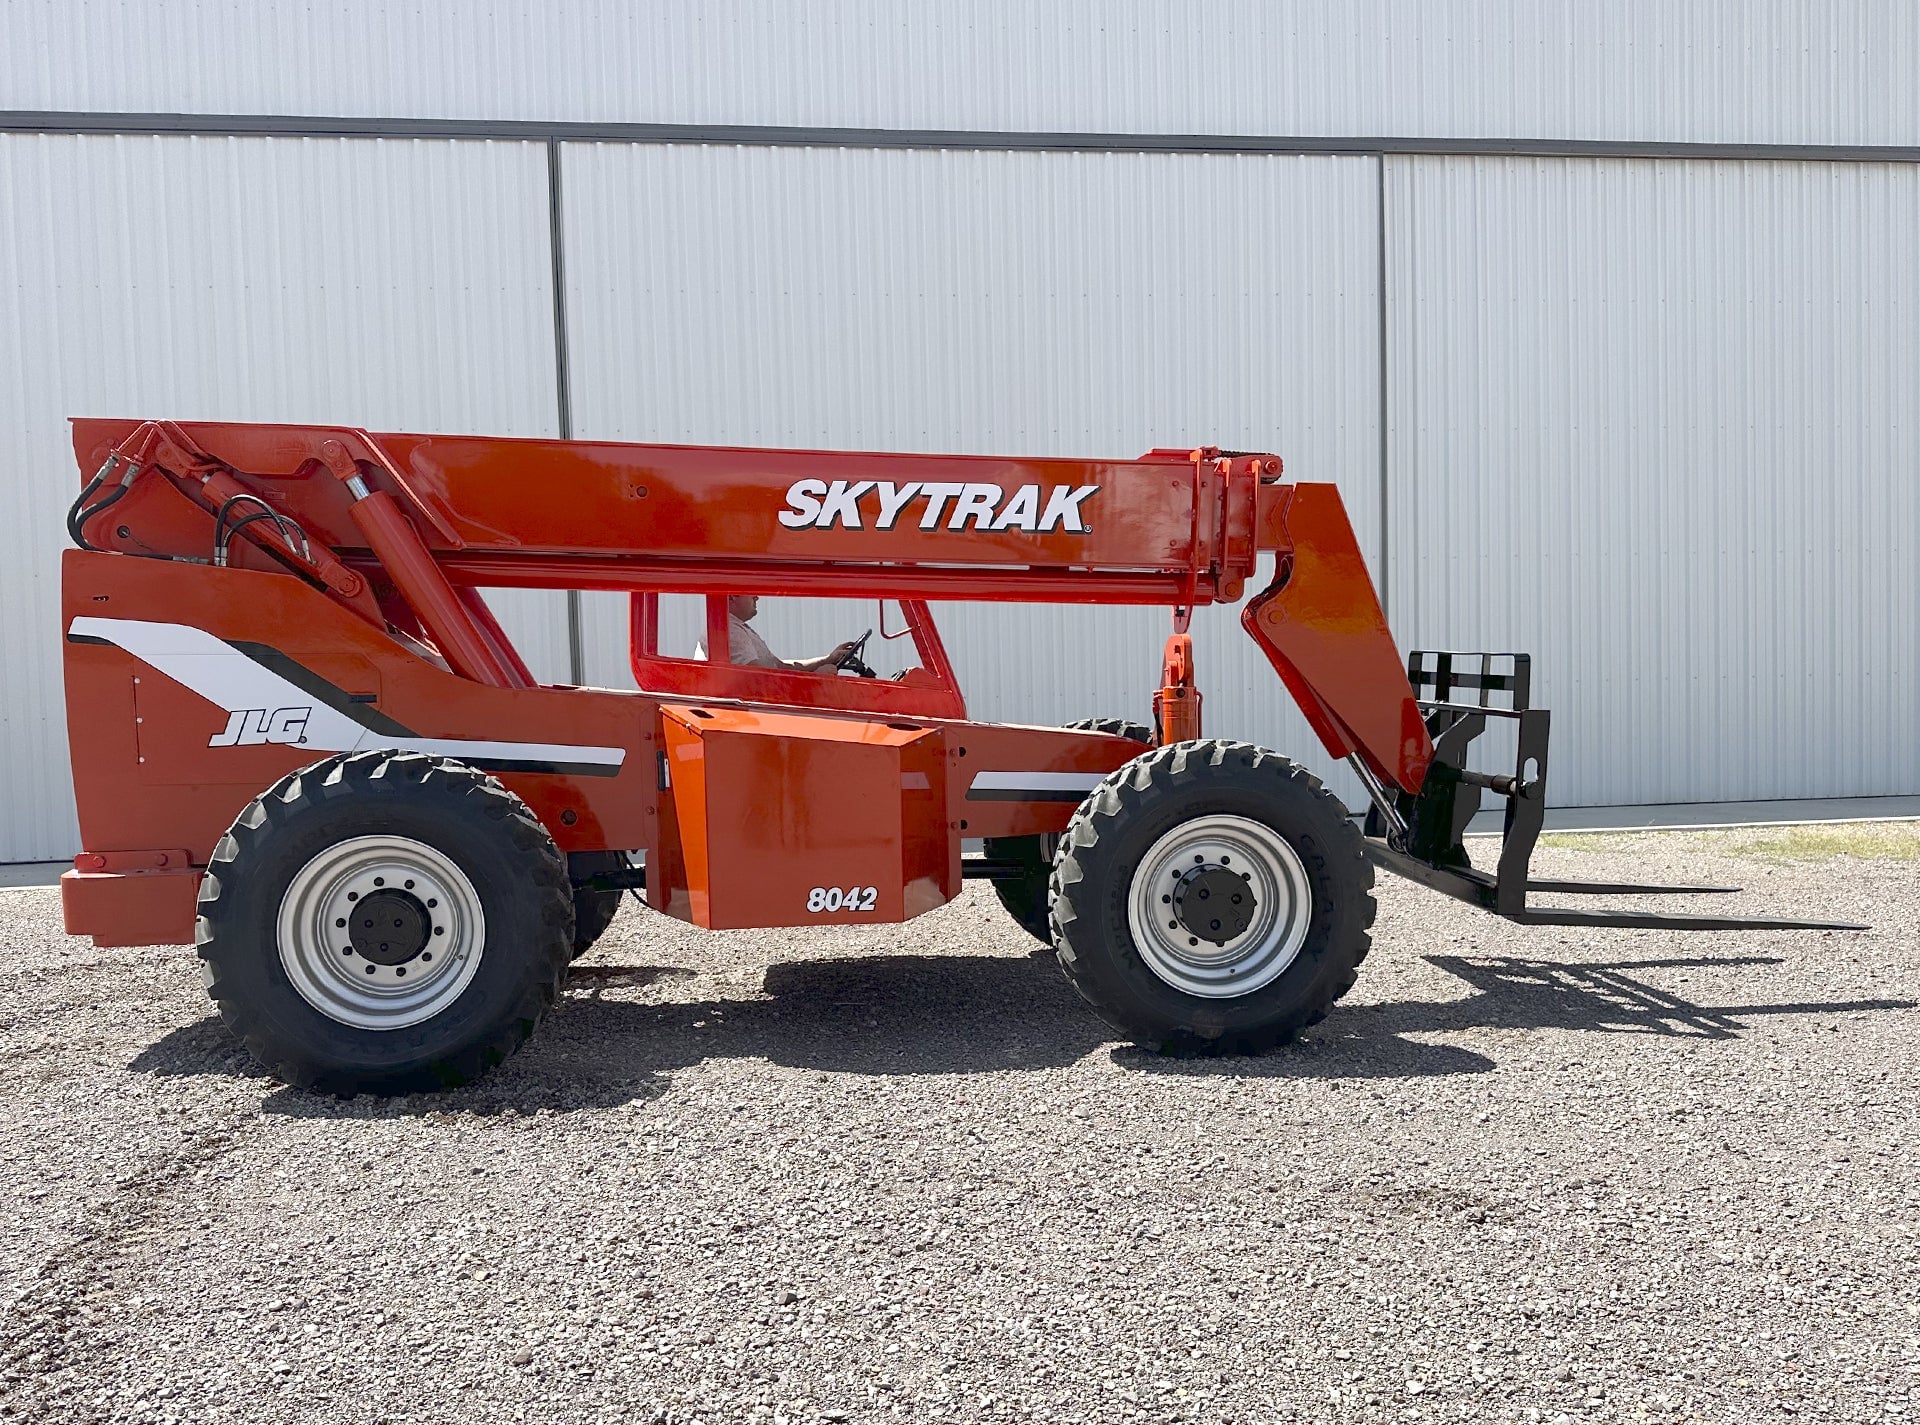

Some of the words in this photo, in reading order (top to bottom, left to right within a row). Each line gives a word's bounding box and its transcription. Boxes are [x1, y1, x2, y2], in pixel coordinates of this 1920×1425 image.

[778, 478, 1101, 533] SKYTRAK
[207, 707, 312, 748] JLG
[806, 886, 879, 913] 8042
